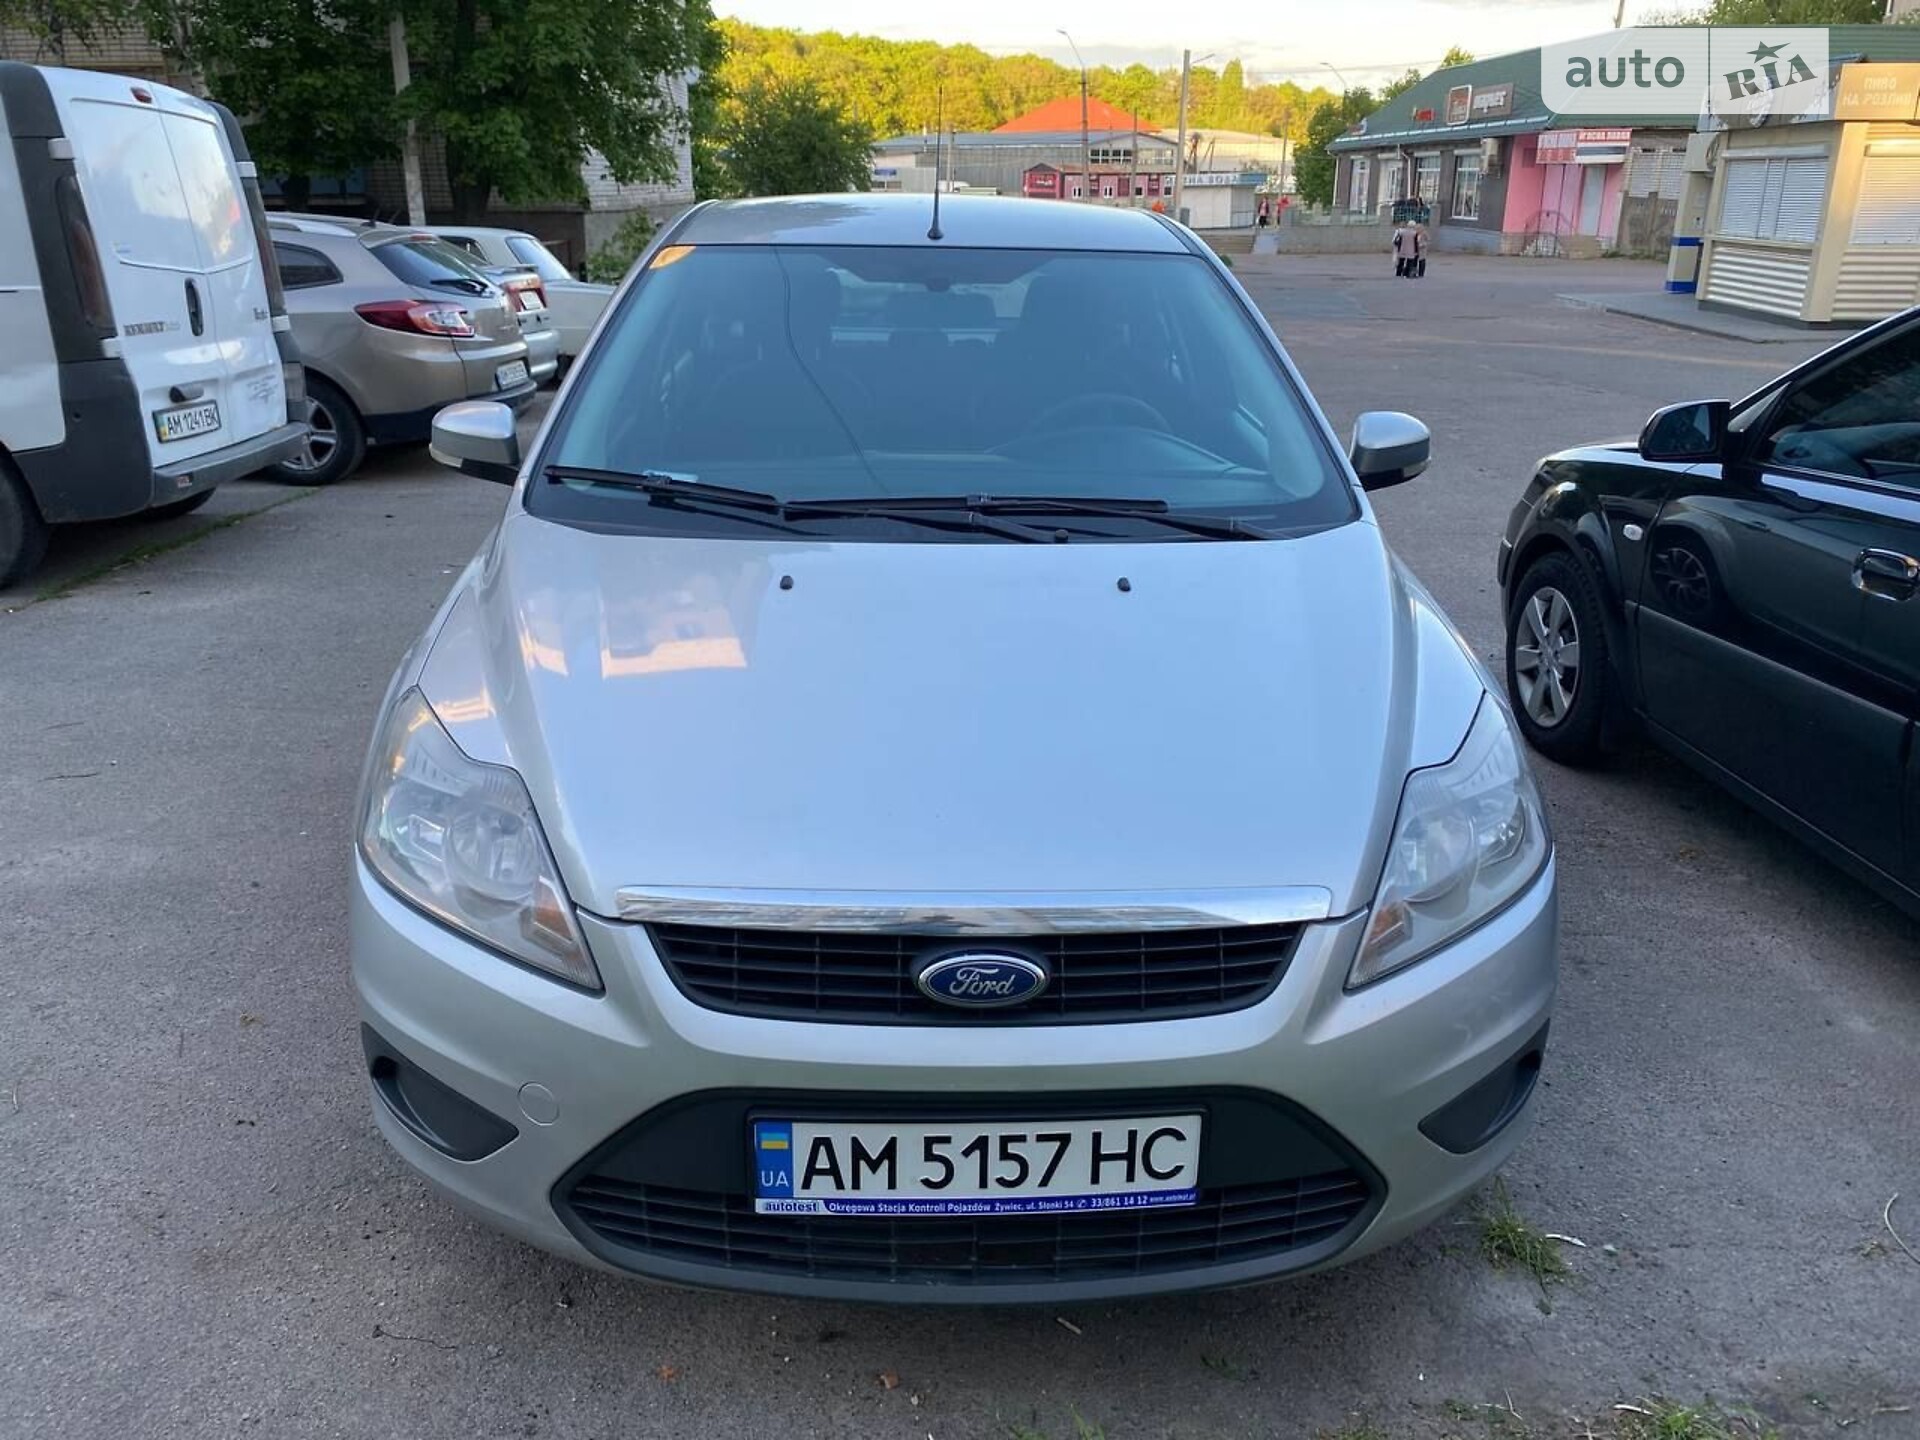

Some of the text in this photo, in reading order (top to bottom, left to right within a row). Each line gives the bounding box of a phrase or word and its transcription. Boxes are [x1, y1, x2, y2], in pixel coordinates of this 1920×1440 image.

[167, 407, 218, 435] AM 1241 BK
[950, 966, 1016, 995] Ford
[801, 1127, 1188, 1191] AM 5157 HC
[761, 1170, 790, 1188] UA
[829, 1203, 875, 1214] Okręgowa
[878, 1203, 906, 1214] Stacja
[908, 1203, 946, 1213] Kontroli
[947, 1202, 991, 1213] Pojazdów
[1137, 1196, 1148, 1205] 12
